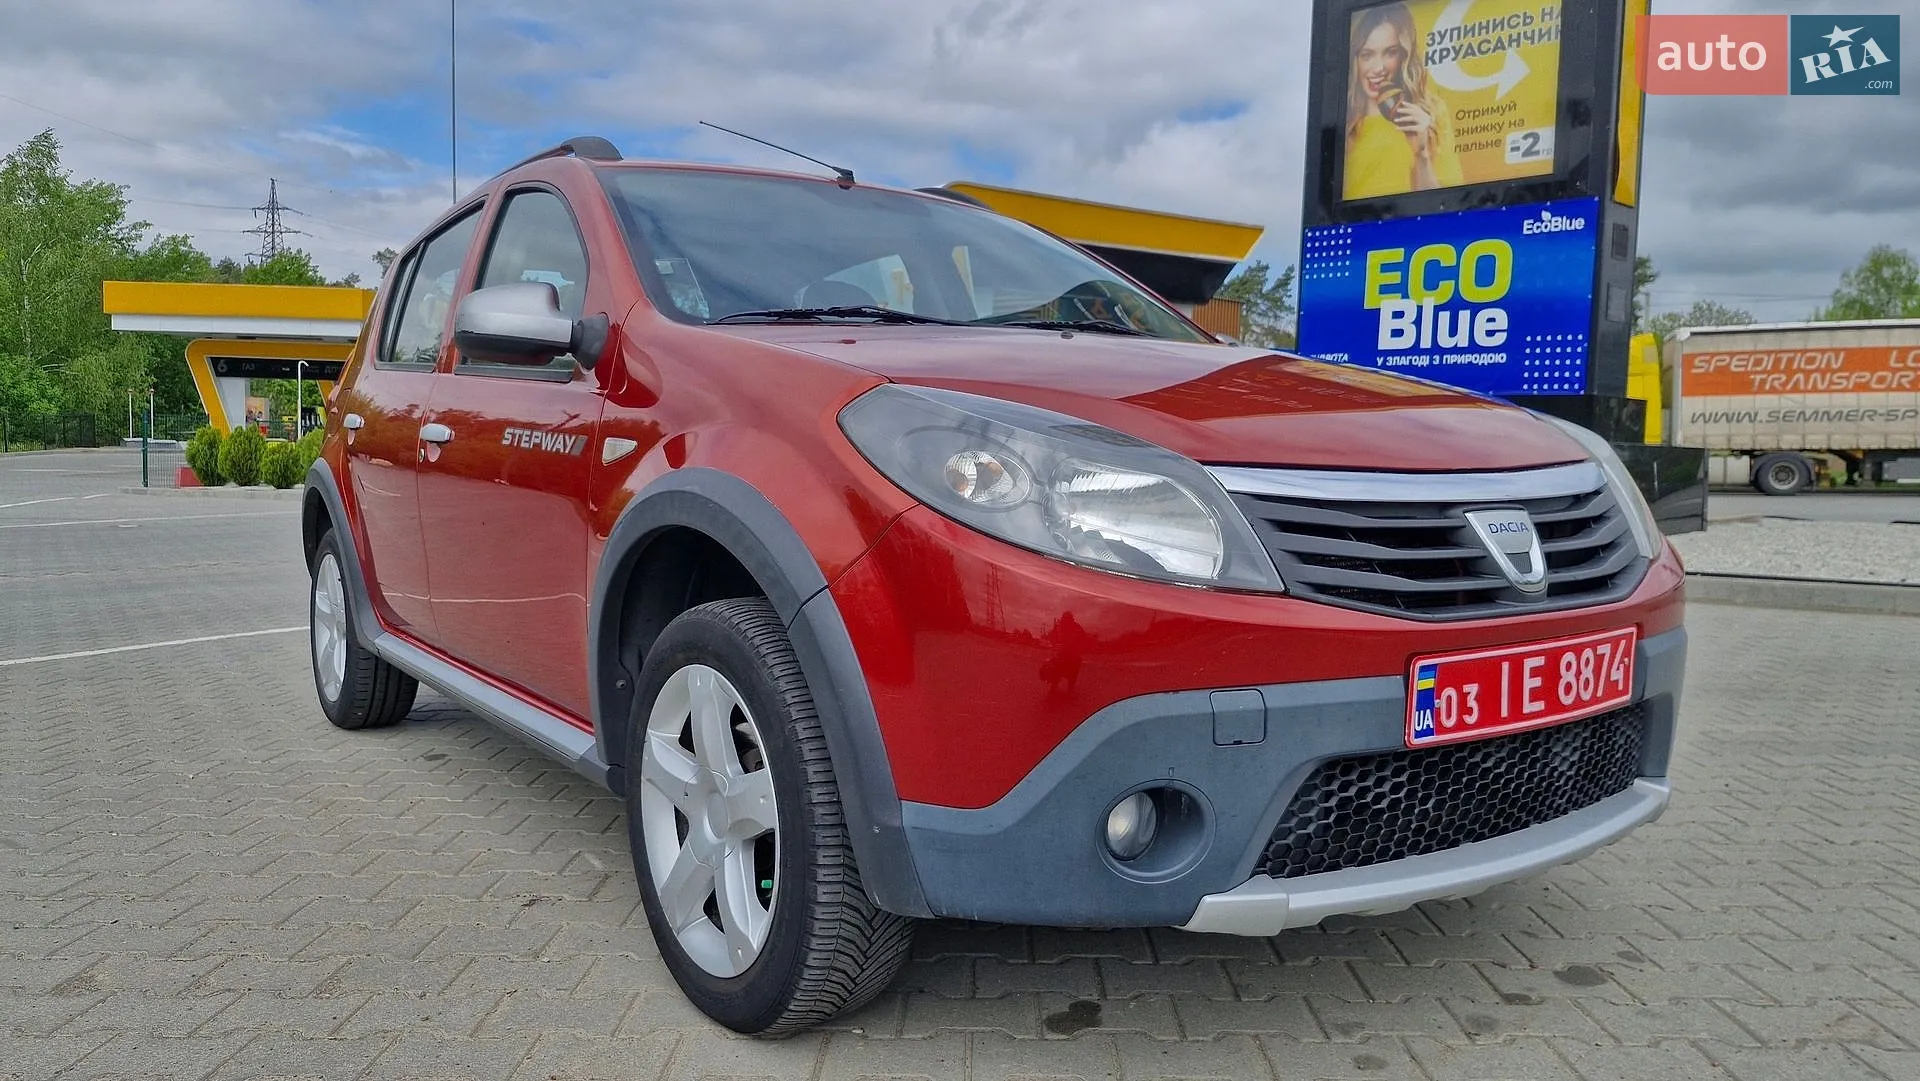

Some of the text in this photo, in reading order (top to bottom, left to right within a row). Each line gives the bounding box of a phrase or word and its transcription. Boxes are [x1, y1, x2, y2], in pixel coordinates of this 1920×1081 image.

[1426, 11, 1535, 47] ЗУПИНИСЬ
[1456, 100, 1517, 120] Отримуй
[1454, 118, 1525, 138] знижку на
[1454, 139, 1502, 153] пальне
[1522, 215, 1585, 235] EcoBlue
[1364, 238, 1514, 310] ECO
[1377, 297, 1509, 351] Blue
[1386, 355, 1430, 367] ЗЛАГОДІ
[1432, 354, 1440, 364] З
[1442, 352, 1507, 366] ПРИРОДОЮ
[1691, 351, 1845, 373] SPEDITION
[1691, 408, 1919, 424] WWW.SEMMER-SP
[502, 427, 576, 454] STEPWAY
[1488, 522, 1529, 534] DACIA
[1440, 640, 1627, 728] 03 IE 8874
[1414, 708, 1434, 731] UA
